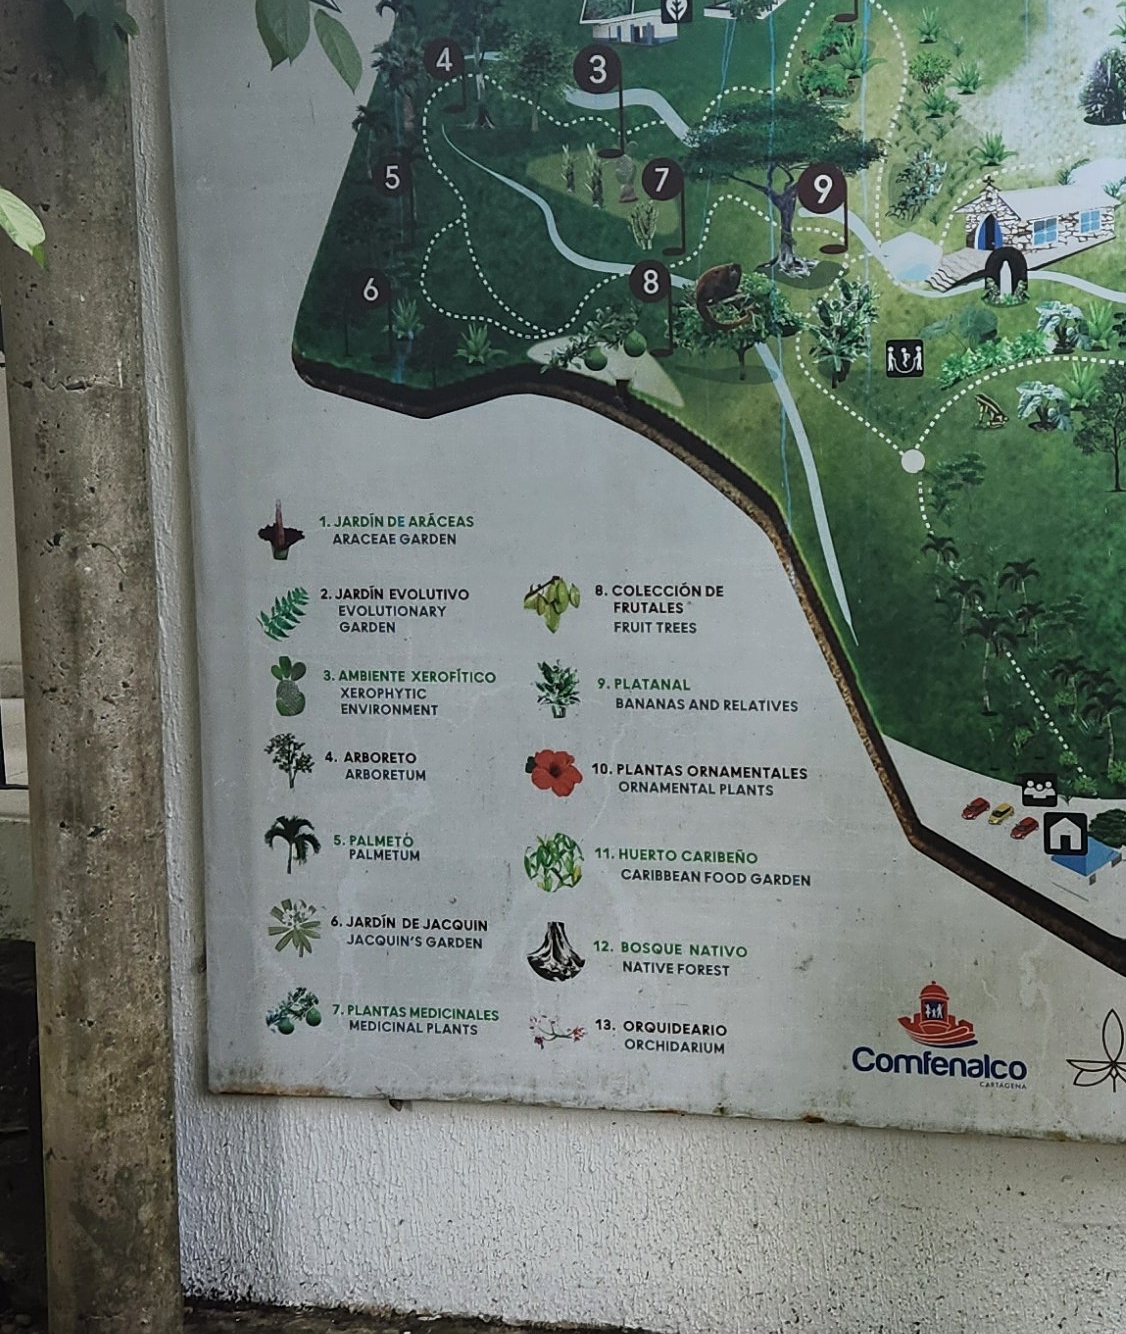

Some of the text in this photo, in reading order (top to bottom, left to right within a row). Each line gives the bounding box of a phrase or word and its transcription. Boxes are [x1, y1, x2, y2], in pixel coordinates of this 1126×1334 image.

[435, 48, 453, 71] 4
[589, 54, 608, 84] 3
[385, 166, 400, 190] 5
[654, 168, 670, 194] 7
[814, 175, 833, 204] 9
[643, 269, 659, 294] 8
[363, 277, 379, 302] 6
[320, 513, 474, 528] 1. JARDÍN DE ARÁCEAS
[333, 533, 456, 546] ARACEAE GARDEN
[321, 585, 469, 601] 2. JARDÍN EVOLUTIVO
[595, 582, 724, 597] 8. COLECCIÓN DE
[338, 605, 446, 617] EVOLUTIONARY
[614, 602, 684, 614] FRUTALES
[340, 622, 396, 633] GARDEN
[614, 621, 697, 634] FRUIT TREES
[323, 668, 496, 684] 3. AMBIENTE XEROFÍTICO
[597, 678, 691, 691] 9. PLATANAL
[341, 688, 427, 700] XEROPHYTIC
[341, 704, 438, 716] ENVIRONMENT
[616, 698, 798, 713] BANANAS AND RELATIVES
[325, 751, 417, 764] 4. ARBORETO
[345, 769, 426, 781] ARBORETUM
[592, 763, 808, 780] 10. PLANTAS ORNAMENTALES
[618, 781, 774, 796] ORNAMENTAL PLANTS
[333, 835, 346, 847] 5.
[350, 849, 420, 861] PALMETUM
[595, 848, 758, 864] 11. HUERTO CARIBEÑO
[621, 869, 811, 886] CARIBBEAN FOOD GARDEN
[330, 914, 488, 932] 6. JARDÍN DE JACQUIN
[426, 937, 483, 949] GARDEN
[593, 941, 748, 958] 12. BOSQUE NATIVO
[623, 961, 729, 977] NATIVE FOREST
[332, 1004, 499, 1022] 7. PLANTAS MEDICINALES
[350, 1020, 478, 1036] MEDICINAL PLANTS
[595, 1019, 727, 1037] 13. ORQUIDEARIO
[624, 1039, 725, 1054] ORCHIDARIUM
[852, 1046, 1028, 1081] Comfenalco
[979, 1081, 1027, 1090] CARTAGENA
